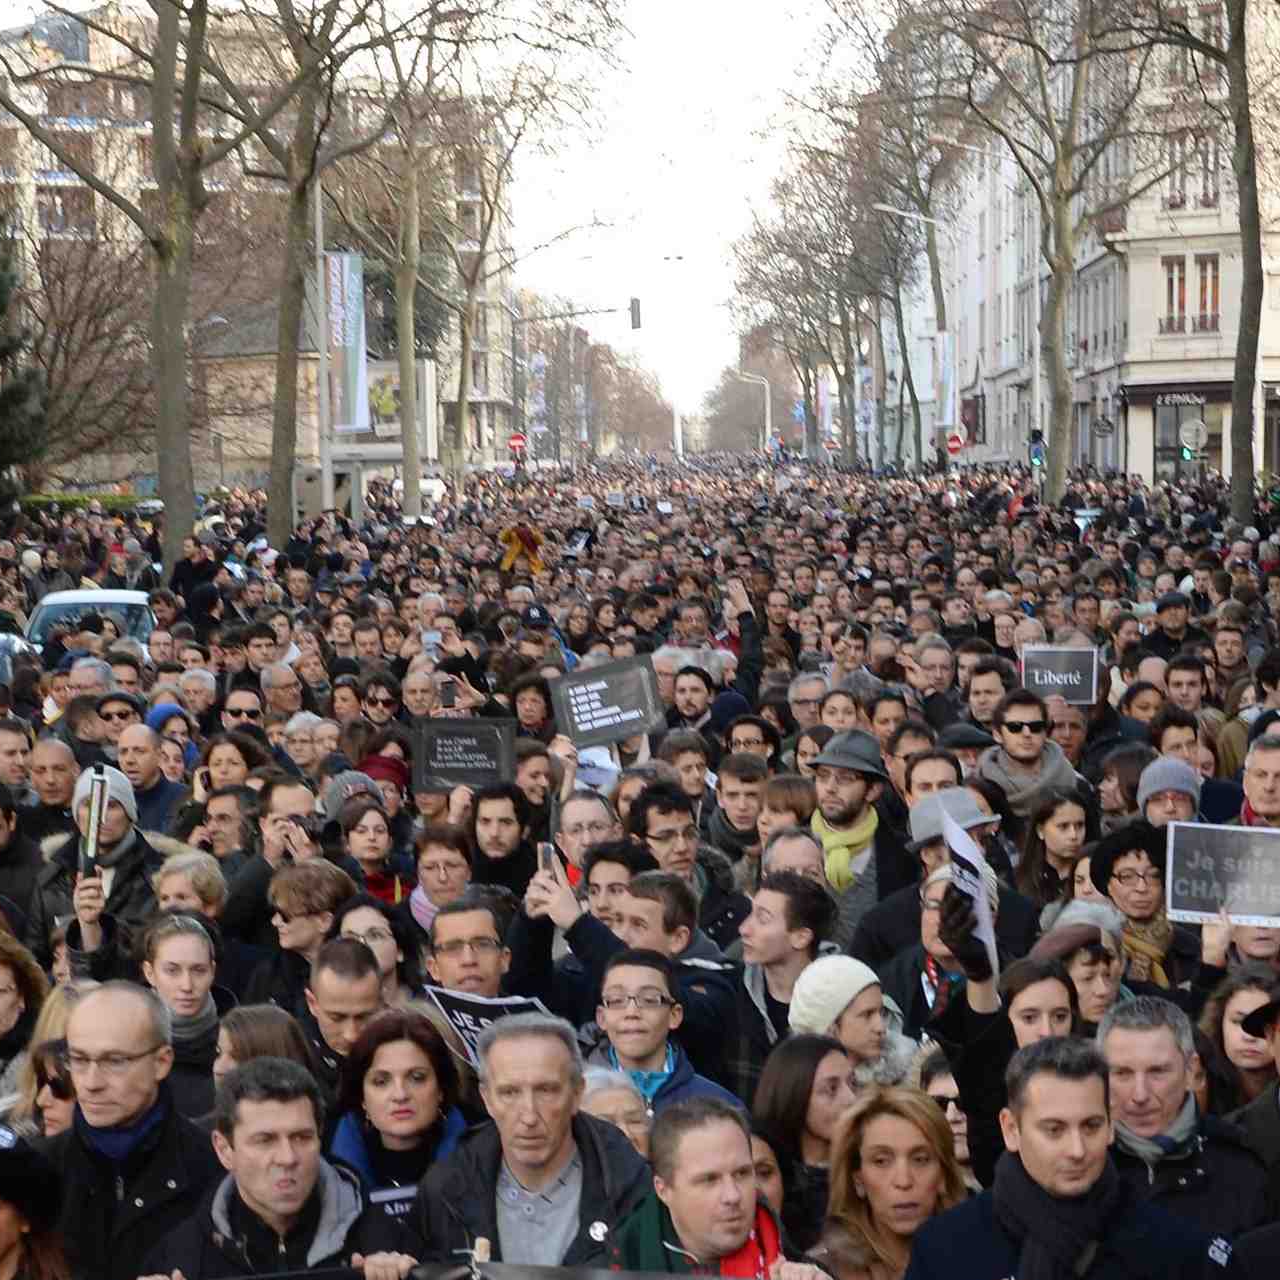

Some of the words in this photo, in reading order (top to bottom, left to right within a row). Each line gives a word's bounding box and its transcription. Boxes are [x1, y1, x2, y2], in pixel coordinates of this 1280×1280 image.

[1033, 669, 1081, 687] Liberté
[1185, 848, 1215, 871] Je
[1222, 851, 1278, 875] suis
[451, 1009, 481, 1033] JE
